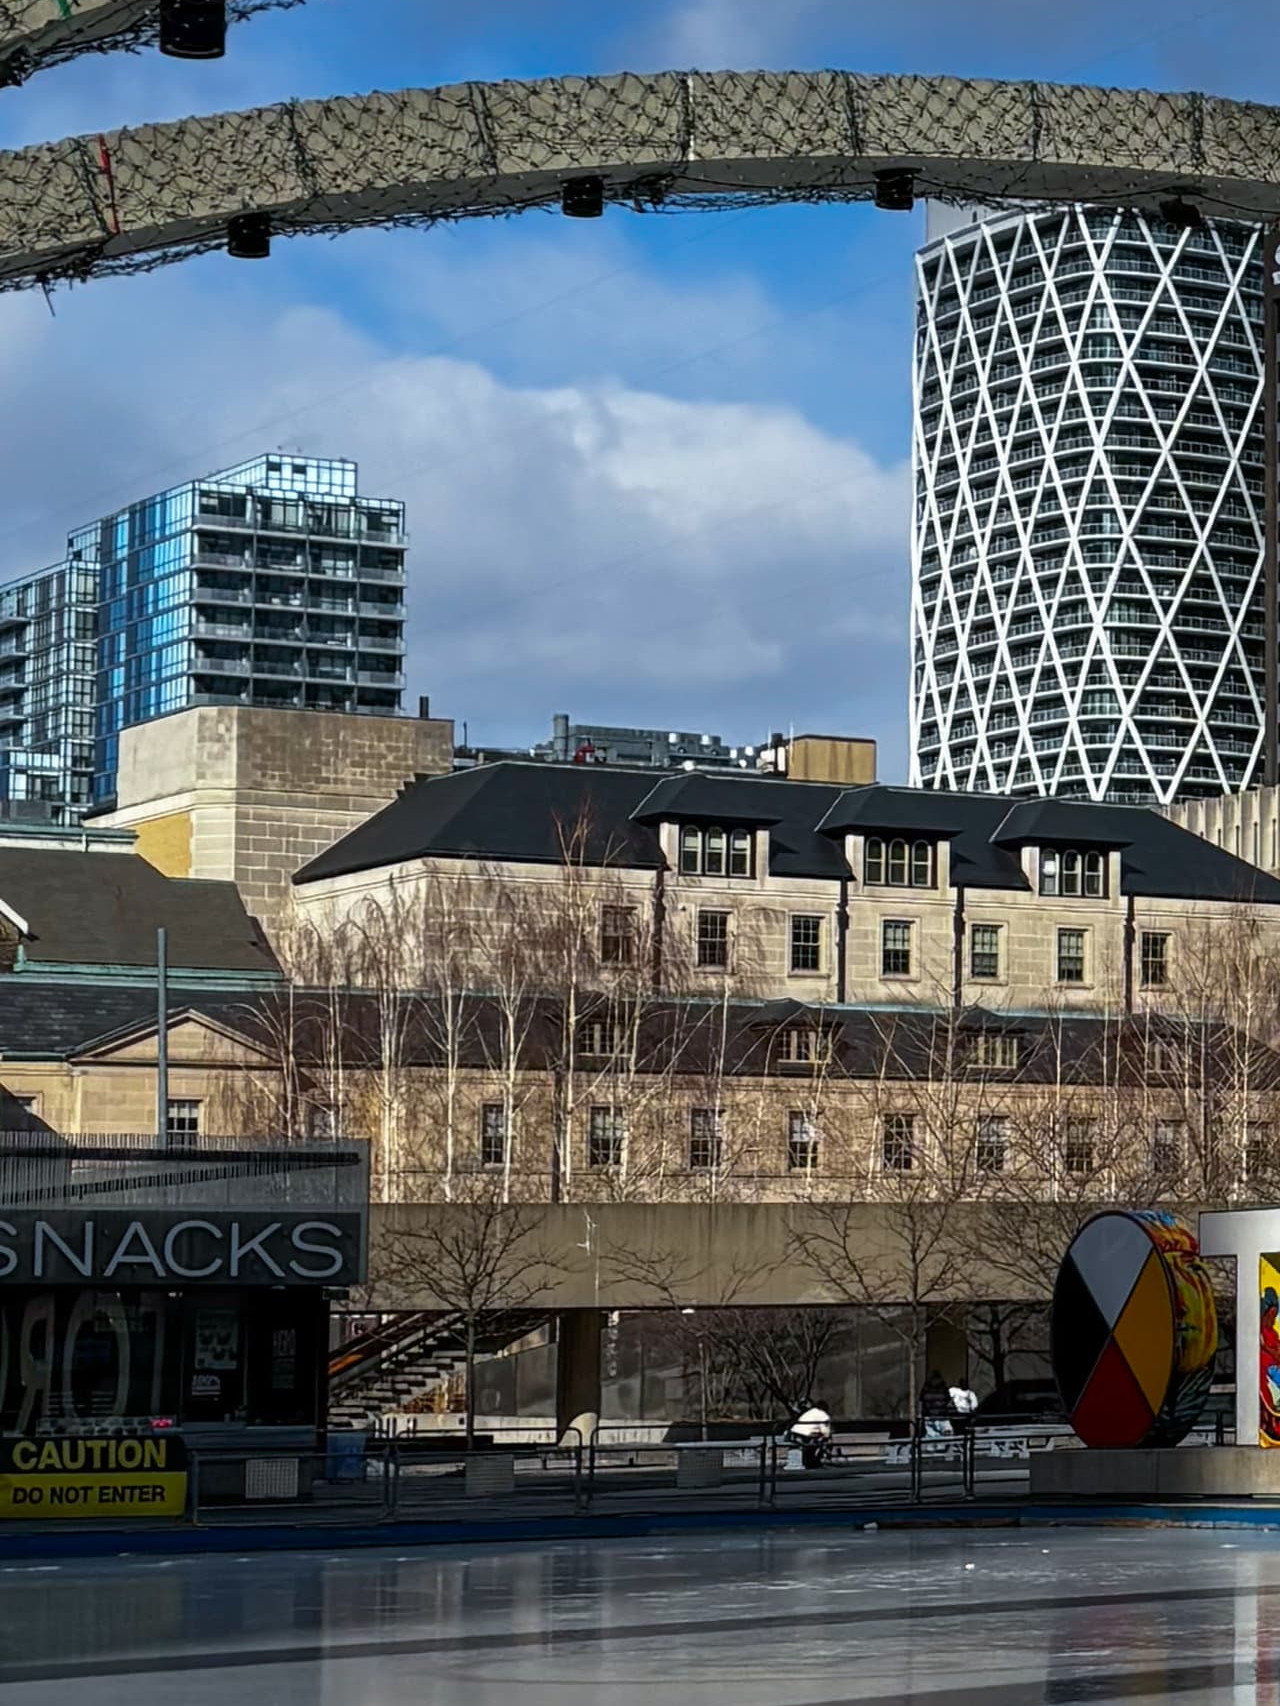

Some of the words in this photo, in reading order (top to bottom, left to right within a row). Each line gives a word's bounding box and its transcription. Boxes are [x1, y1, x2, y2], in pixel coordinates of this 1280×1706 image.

[12, 1439, 168, 1471] CAUTION
[12, 1487, 43, 1504] DO
[50, 1486, 93, 1504] NOT
[98, 1485, 166, 1503] ENTER
